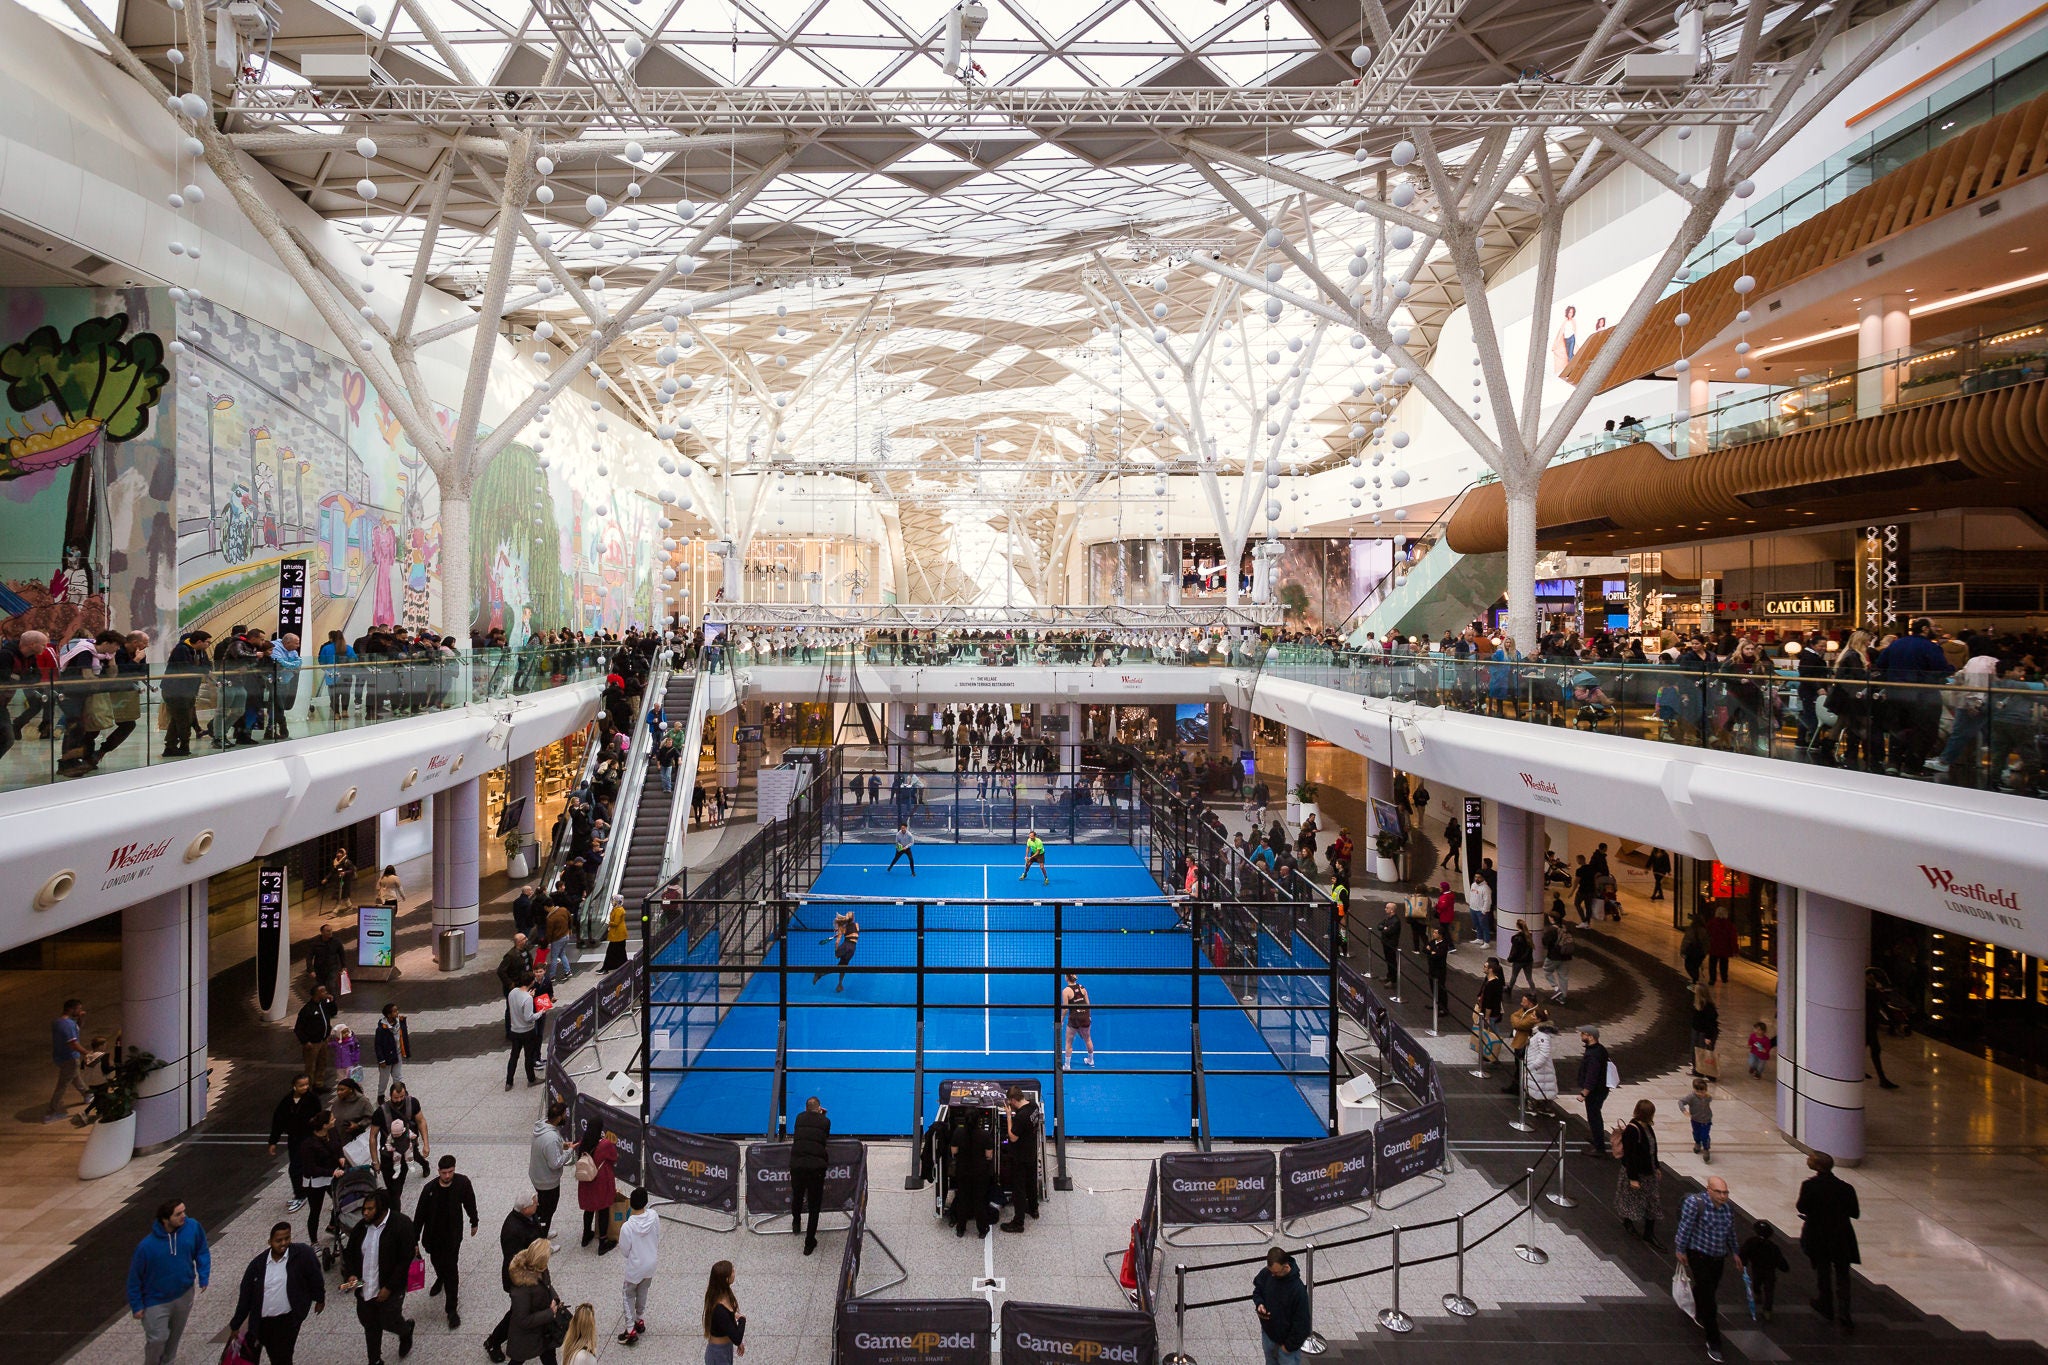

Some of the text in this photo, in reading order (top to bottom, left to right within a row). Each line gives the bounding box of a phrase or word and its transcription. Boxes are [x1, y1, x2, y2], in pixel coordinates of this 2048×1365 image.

[295, 570, 304, 582] 2
[1767, 600, 1835, 613] CATCH ME
[1518, 772, 1559, 795] Westfield
[1466, 804, 1472, 813] 8
[105, 836, 175, 874] Westfield
[101, 864, 154, 891] LONDON W12
[273, 877, 281, 888] 2
[1917, 864, 2022, 911] Westfield
[272, 895, 279, 903] A
[1944, 899, 2023, 930] LONDON W12
[1383, 1126, 1440, 1158] Game4Padel
[653, 1152, 728, 1180] Game4Padel
[1291, 1155, 1366, 1185] Game4Padel
[1172, 1176, 1266, 1194] Game4Padel
[855, 1332, 976, 1354] Game4Padel
[1016, 1332, 1139, 1364] Game4Padel
